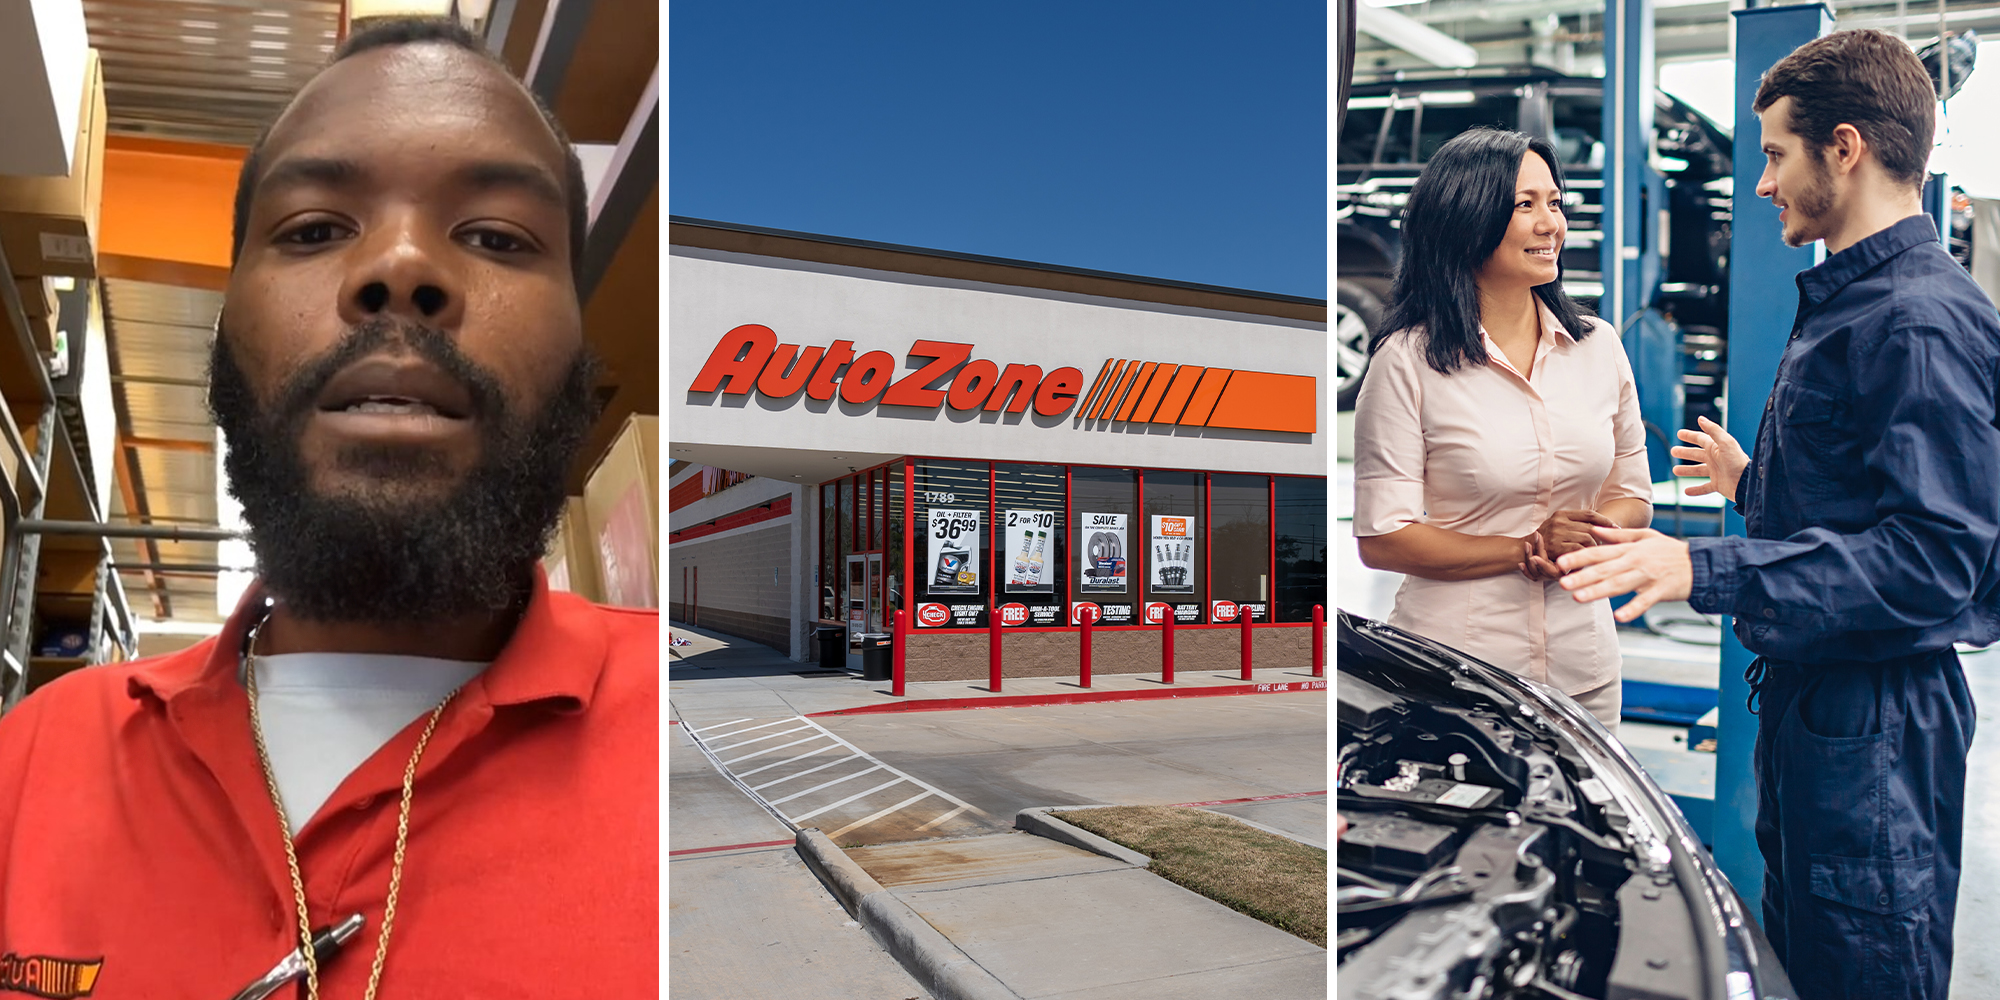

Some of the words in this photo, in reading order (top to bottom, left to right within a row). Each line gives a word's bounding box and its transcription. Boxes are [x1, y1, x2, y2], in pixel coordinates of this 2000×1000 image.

[688, 323, 1084, 417] AutoZone
[924, 492, 955, 503] 1789
[952, 511, 972, 519] FILTER
[1007, 512, 1018, 527] 2
[1032, 513, 1053, 528] $10
[1092, 515, 1117, 525] SAVE
[1161, 521, 1174, 532] $10
[1003, 607, 1024, 621] FREE
[1103, 605, 1131, 615] TESTING
[1216, 605, 1235, 617] FREE
[1257, 683, 1271, 692] FIRE
[1273, 682, 1288, 691] LANE
[1300, 682, 1310, 690] NO
